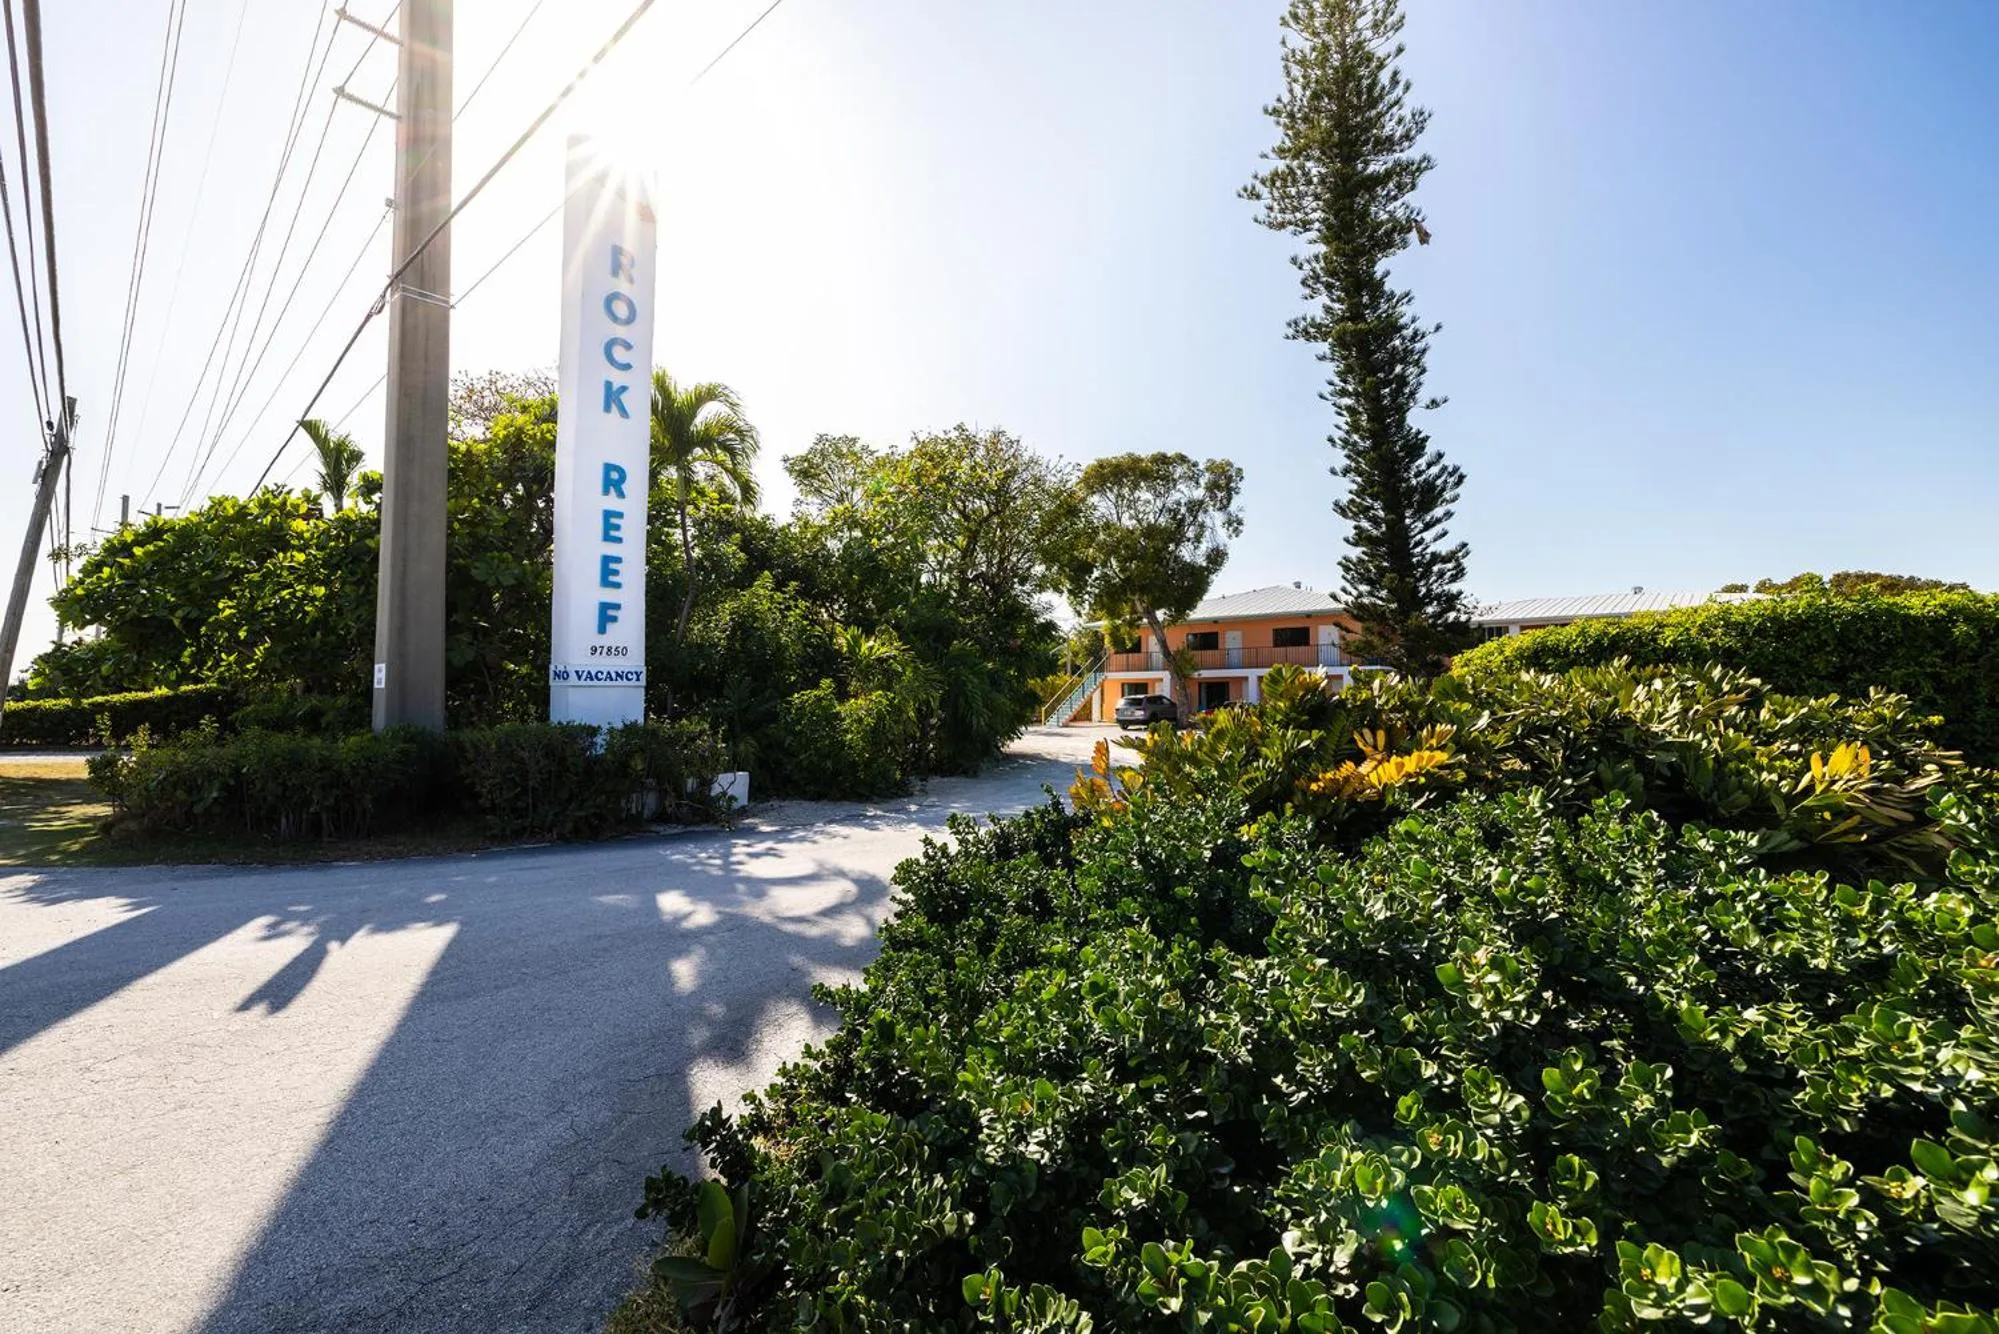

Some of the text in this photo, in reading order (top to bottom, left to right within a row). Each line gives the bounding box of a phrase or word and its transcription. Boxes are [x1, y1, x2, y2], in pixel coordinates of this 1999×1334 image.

[597, 244, 637, 635] ROCK REEF
[590, 645, 629, 657] 97850
[553, 669, 643, 682] NO VACANCY
